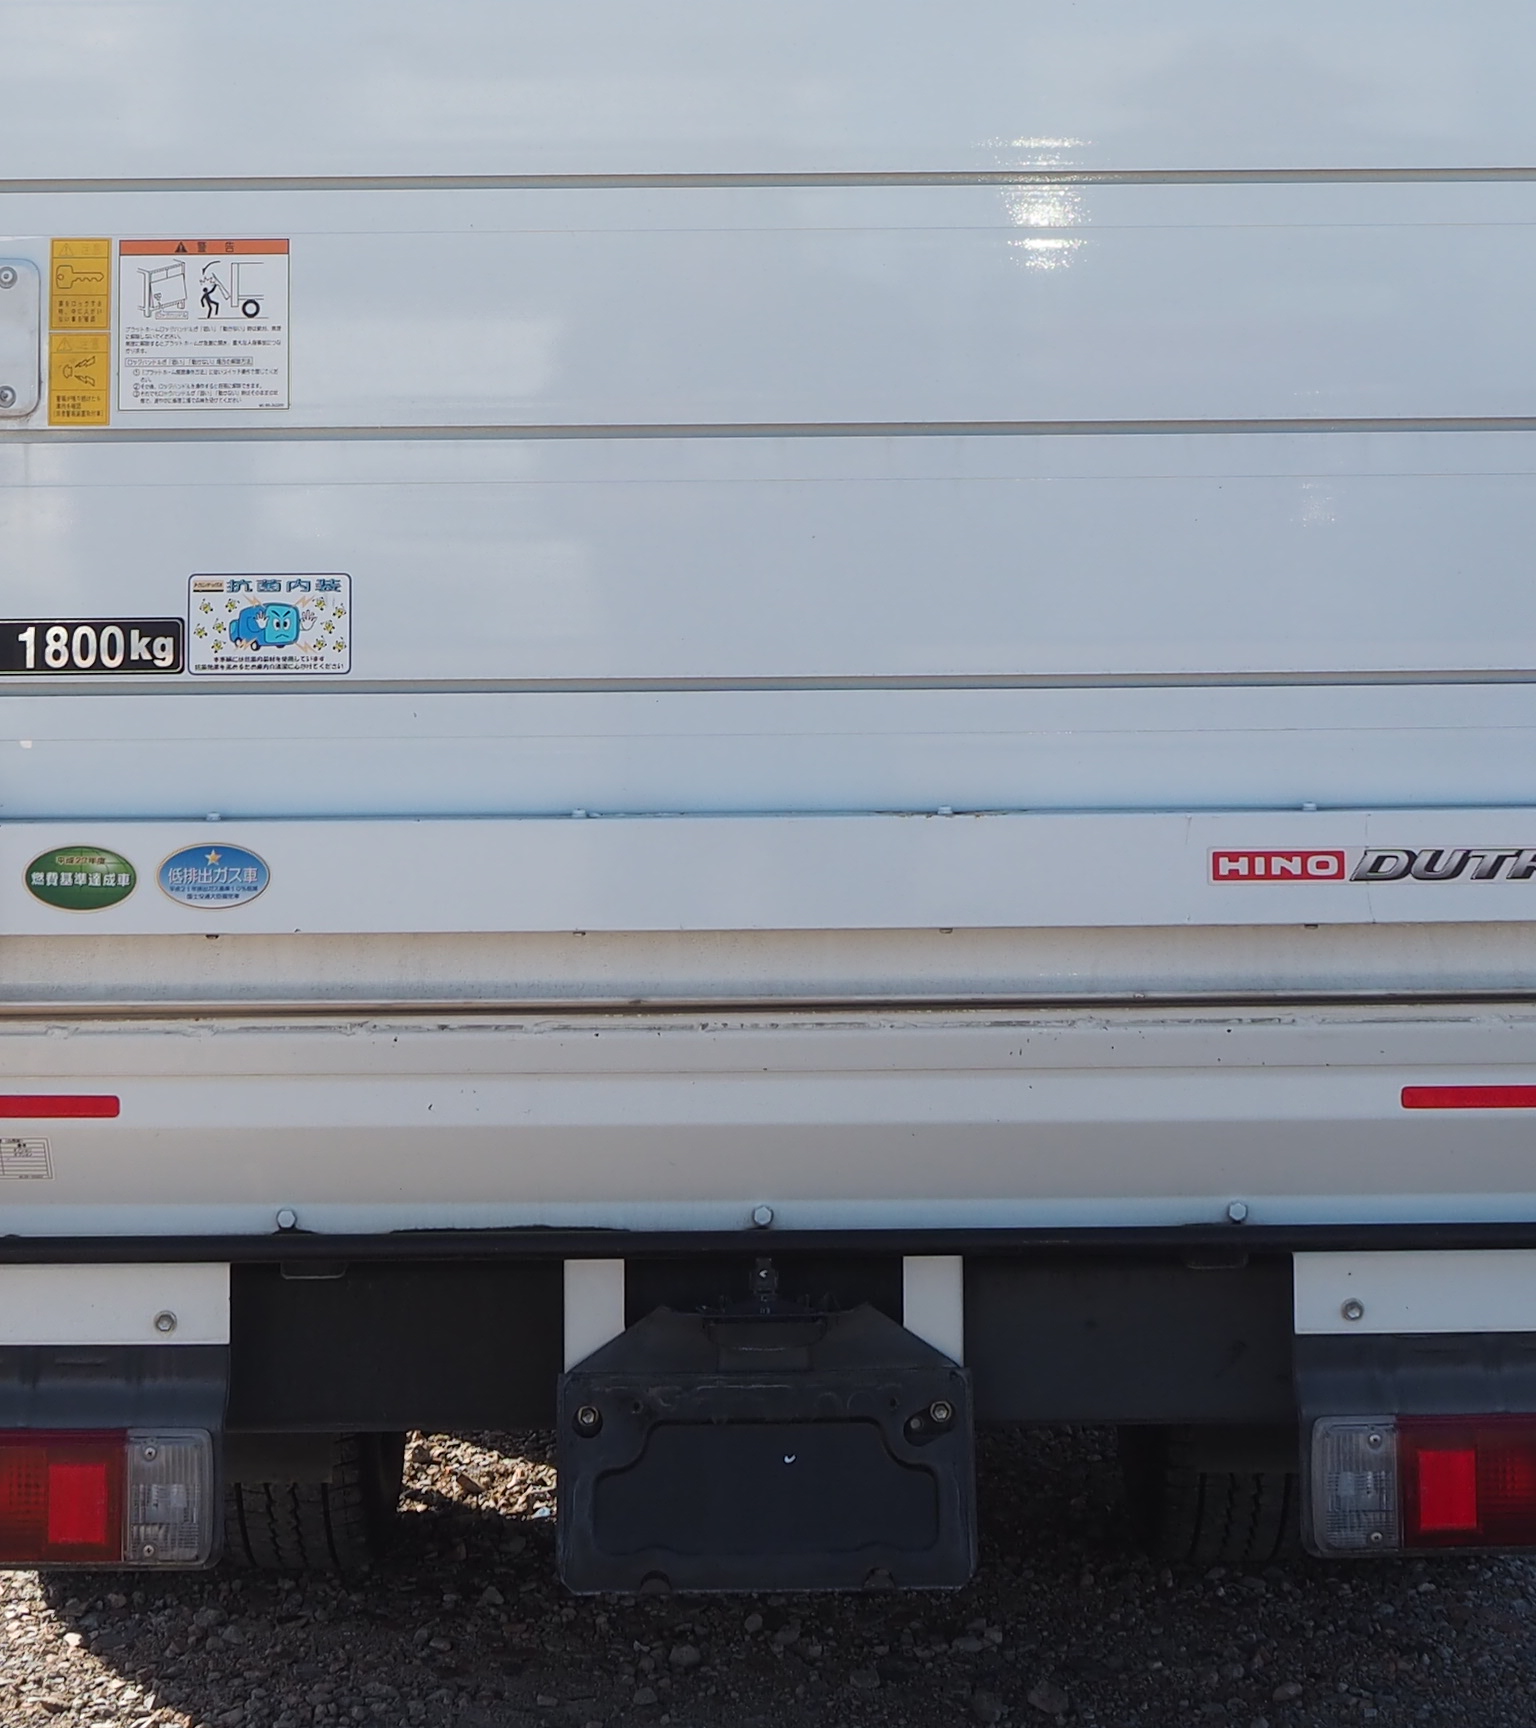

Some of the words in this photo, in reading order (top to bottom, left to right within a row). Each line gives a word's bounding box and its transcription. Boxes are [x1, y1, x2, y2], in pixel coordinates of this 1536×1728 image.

[18, 625, 175, 670] 1800kg
[168, 867, 258, 884] 低排出ガス車
[1218, 854, 1339, 877] HINO
[31, 872, 130, 886] 燃費基準達成車
